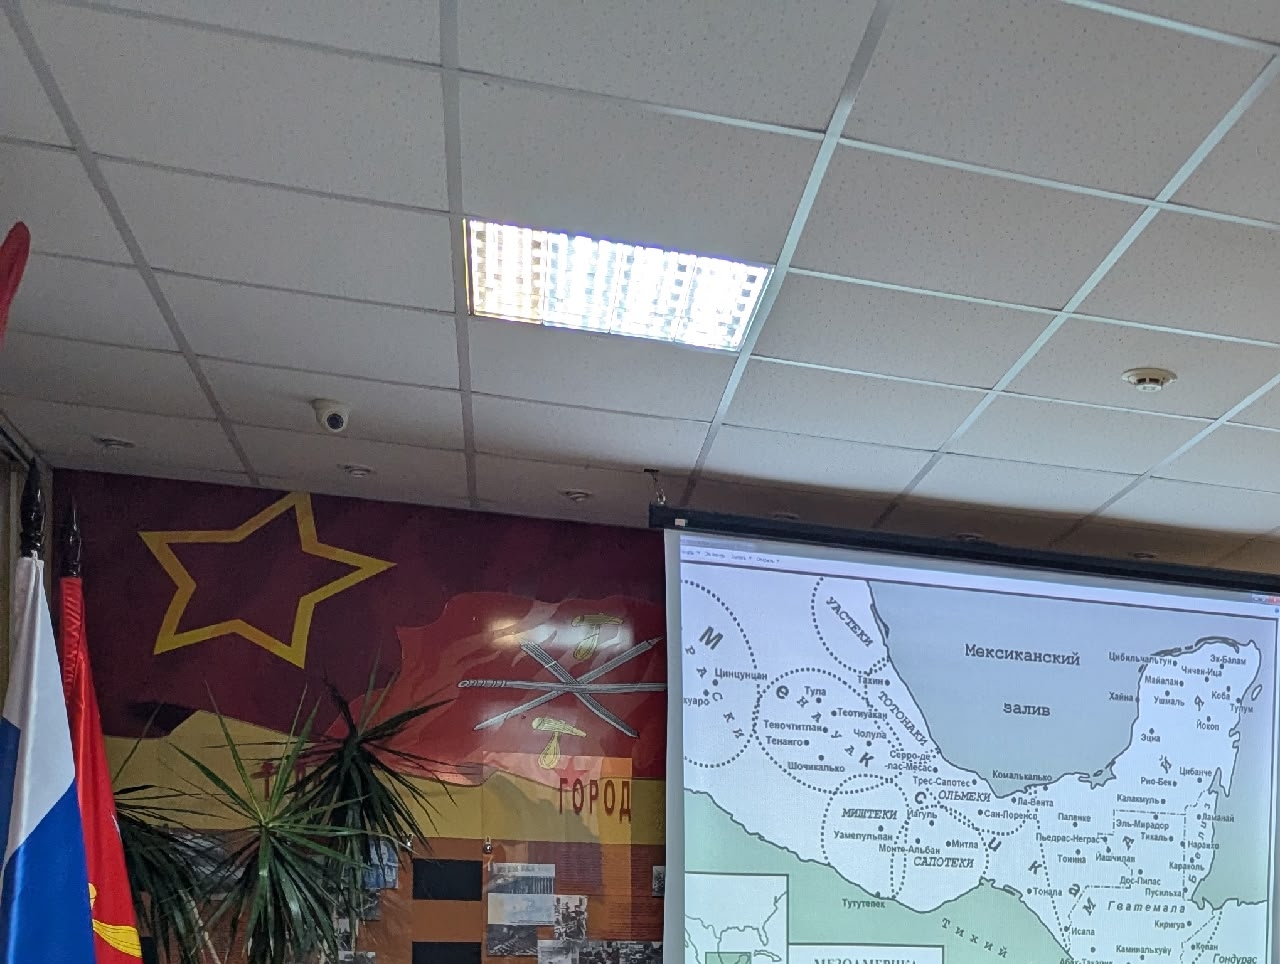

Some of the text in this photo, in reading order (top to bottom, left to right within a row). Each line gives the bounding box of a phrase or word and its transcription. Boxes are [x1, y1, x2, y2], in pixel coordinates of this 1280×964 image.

[826, 596, 874, 648] УАСТЕКИ
[965, 643, 1081, 667] Мексиканский
[714, 668, 768, 681] Цинцунцан
[804, 686, 827, 697] Тула
[1109, 691, 1134, 702] Хайна
[1211, 690, 1231, 700] Коба
[1154, 695, 1185, 707] Ушмаль
[1002, 702, 1051, 718] залив
[1230, 703, 1254, 714] Тулум
[837, 708, 888, 721] Теотиуакан
[878, 690, 930, 747] ТОТОНАКИ
[763, 719, 822, 732] Теночтитлан
[854, 729, 888, 740] Чолула
[1141, 733, 1161, 743] Эцна
[765, 736, 803, 747] Тенанго
[788, 761, 846, 773] Шочикалько
[1179, 766, 1212, 777] Цибанче
[913, 776, 971, 787] Трес-Сапотес
[992, 770, 1053, 782] Комалькалько
[1141, 776, 1172, 787] Рио-Бек
[560, 777, 631, 824] ГОРОД
[938, 790, 991, 803] ОЛЬМЕКИ
[1117, 793, 1160, 806] Калакмуль
[841, 808, 898, 820] МИШТЕКИ
[984, 809, 1038, 821] Сан-Лоренсо
[1058, 812, 1092, 823] Паленке
[1116, 818, 1170, 830] Эль-Мирадор
[1036, 832, 1100, 844] Пьедрас-Неграс
[1141, 832, 1168, 842] Тикаль
[879, 843, 941, 855] Монте-Альбан
[951, 839, 979, 850] Митла
[1187, 840, 1220, 850] Наранхо
[914, 856, 975, 868] САПОТЕКИ
[1057, 854, 1087, 864] Тонина
[1169, 861, 1205, 871] Караколь
[1120, 876, 1161, 886] Дос-Пилас
[1033, 887, 1063, 898] Тонала
[1145, 887, 1182, 898] Пусильха
[842, 898, 886, 909] Тутутепек
[1108, 901, 1186, 913] Гватемала
[1154, 920, 1185, 930] Киригуа
[1195, 942, 1219, 952] Копан
[1212, 953, 1258, 964] Гондурас
